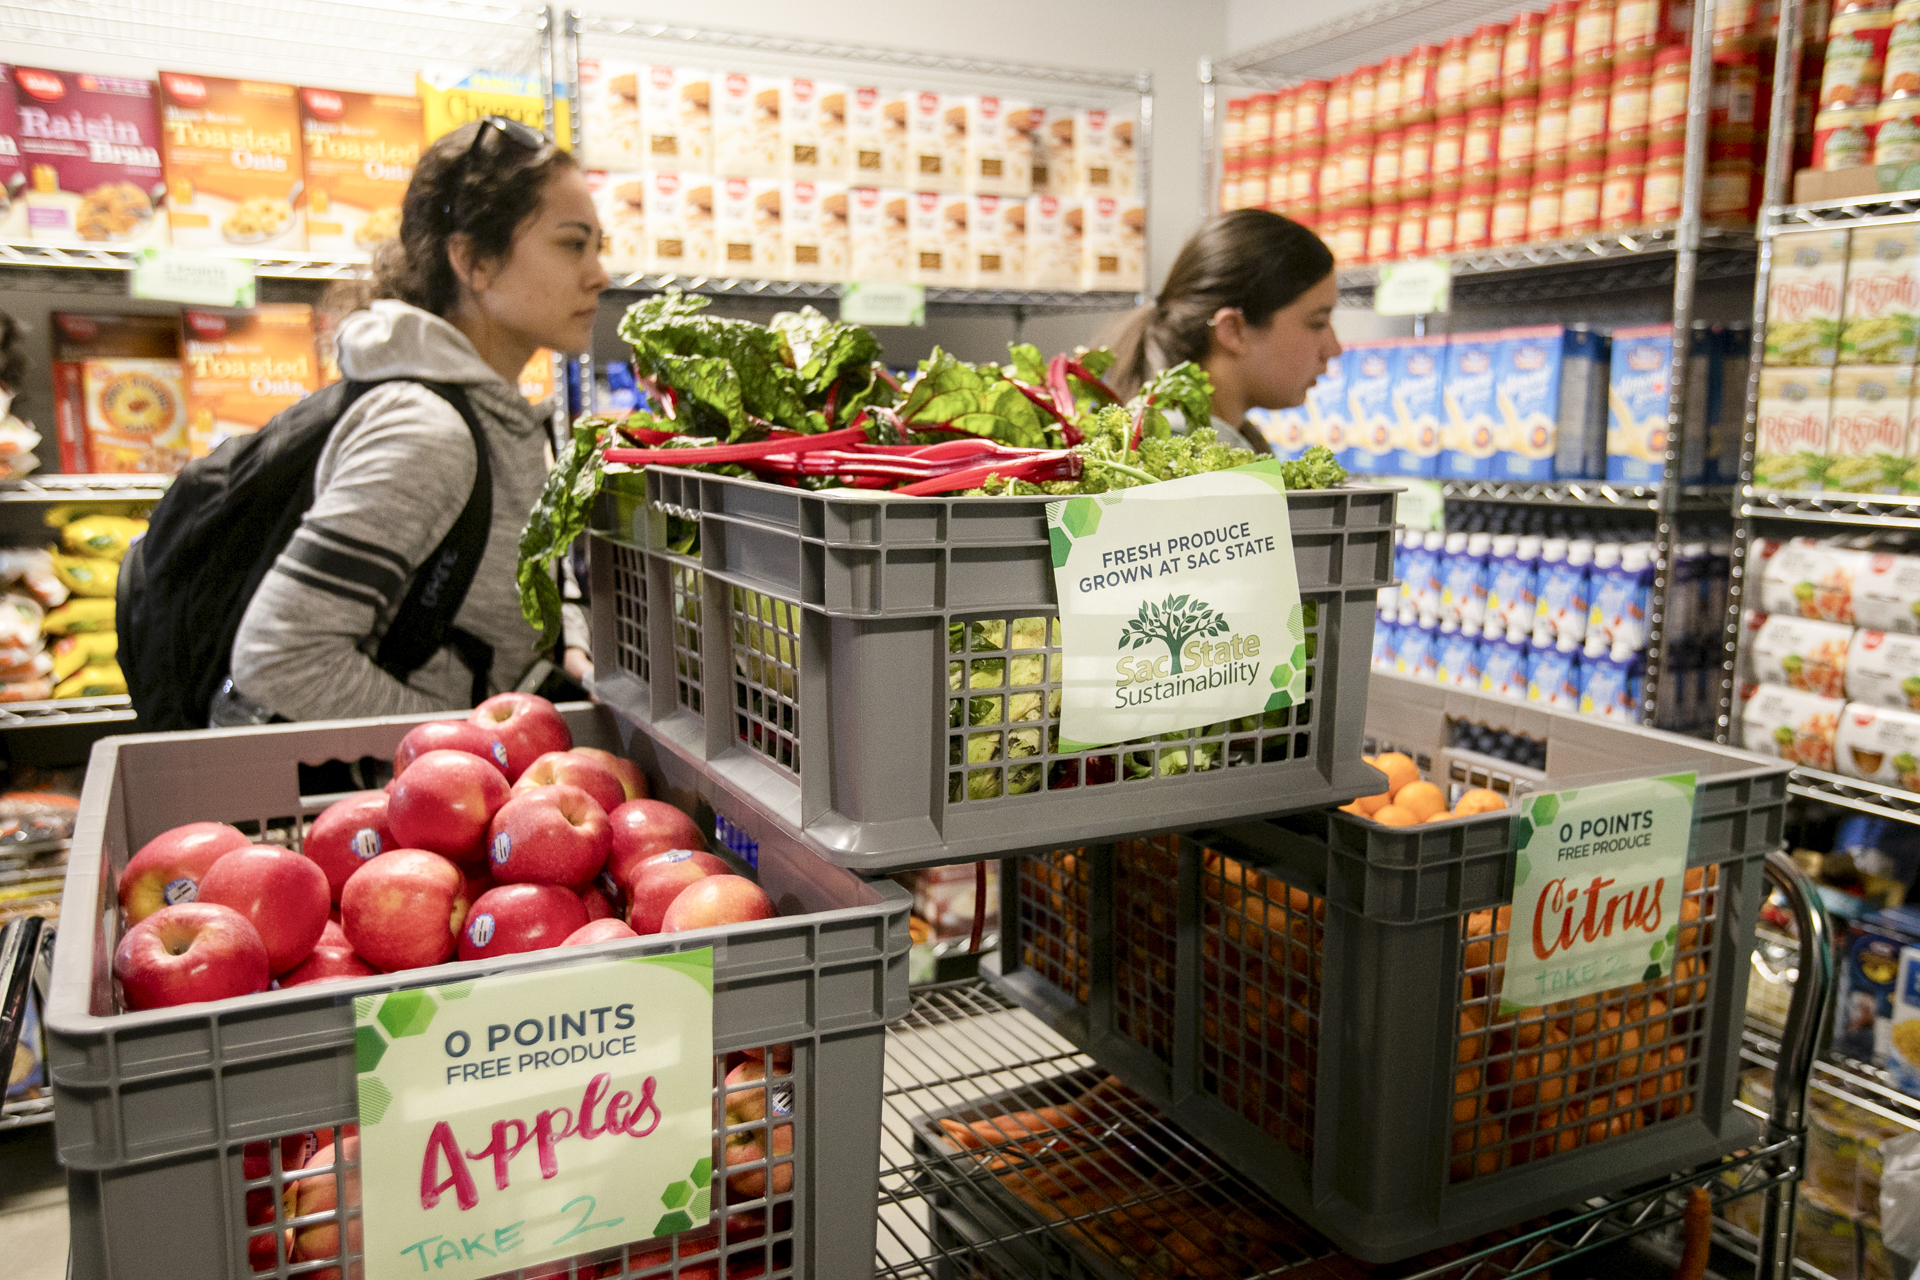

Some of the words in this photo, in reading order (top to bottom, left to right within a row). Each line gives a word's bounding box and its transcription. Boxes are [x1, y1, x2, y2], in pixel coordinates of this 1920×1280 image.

[18, 106, 143, 146] Raisin
[167, 120, 292, 154] Toasted
[88, 138, 163, 167] Bran
[188, 353, 308, 380] Toasted
[1079, 563, 1153, 593] GROWN
[1159, 557, 1181, 577] AT
[1187, 549, 1221, 570] SAC
[1226, 536, 1275, 561] STATE
[1102, 541, 1162, 568] FRESH
[1167, 522, 1251, 554] PRODUCE
[1116, 655, 1171, 687] Sac
[1183, 633, 1261, 672] State
[1115, 662, 1260, 709] Sustainability
[1557, 843, 1590, 862] FREE
[1592, 833, 1652, 855] PRODUCE
[1580, 809, 1653, 840] POINTS
[1532, 876, 1665, 960] Citrus
[487, 1003, 636, 1052] POINTS
[446, 1057, 512, 1085] FREE
[518, 1035, 637, 1073] PRODUCE
[420, 1072, 662, 1211] Apples
[400, 1220, 526, 1272] TAKE
[552, 1194, 625, 1245] 2
